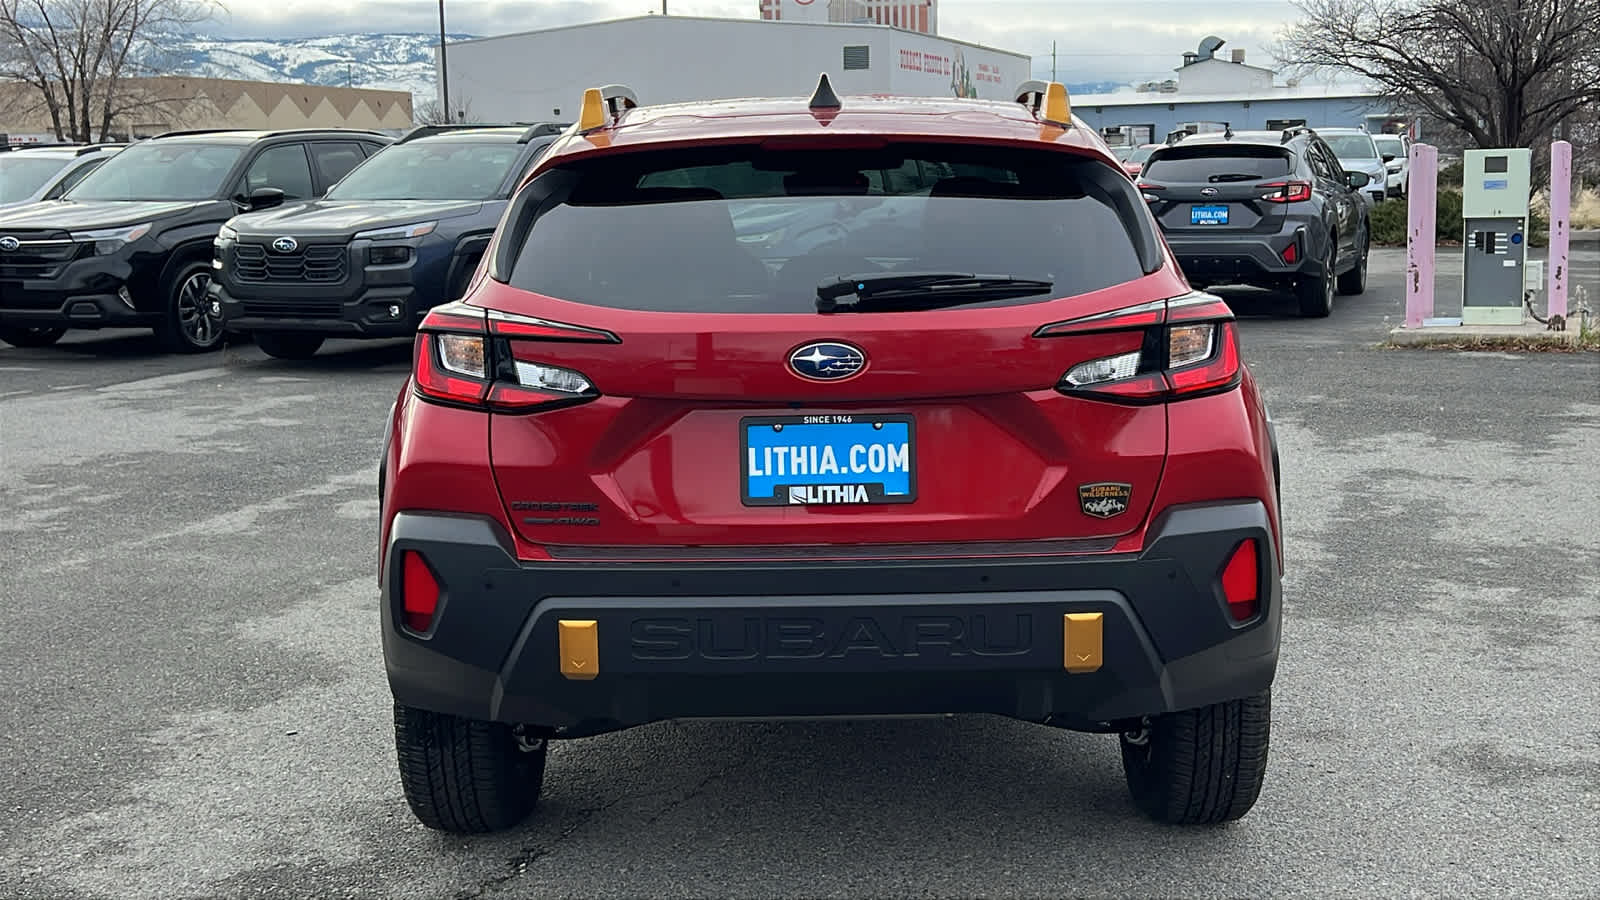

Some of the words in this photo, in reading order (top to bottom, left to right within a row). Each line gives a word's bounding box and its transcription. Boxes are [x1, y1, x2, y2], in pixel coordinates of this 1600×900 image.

[1192, 211, 1228, 219] LITHIA.COM
[803, 416, 830, 424] SINCE
[832, 415, 853, 423] 1946
[748, 443, 909, 476] LITHIA.COM
[807, 484, 869, 503] LITHIA
[631, 614, 1033, 660] SUBARU
